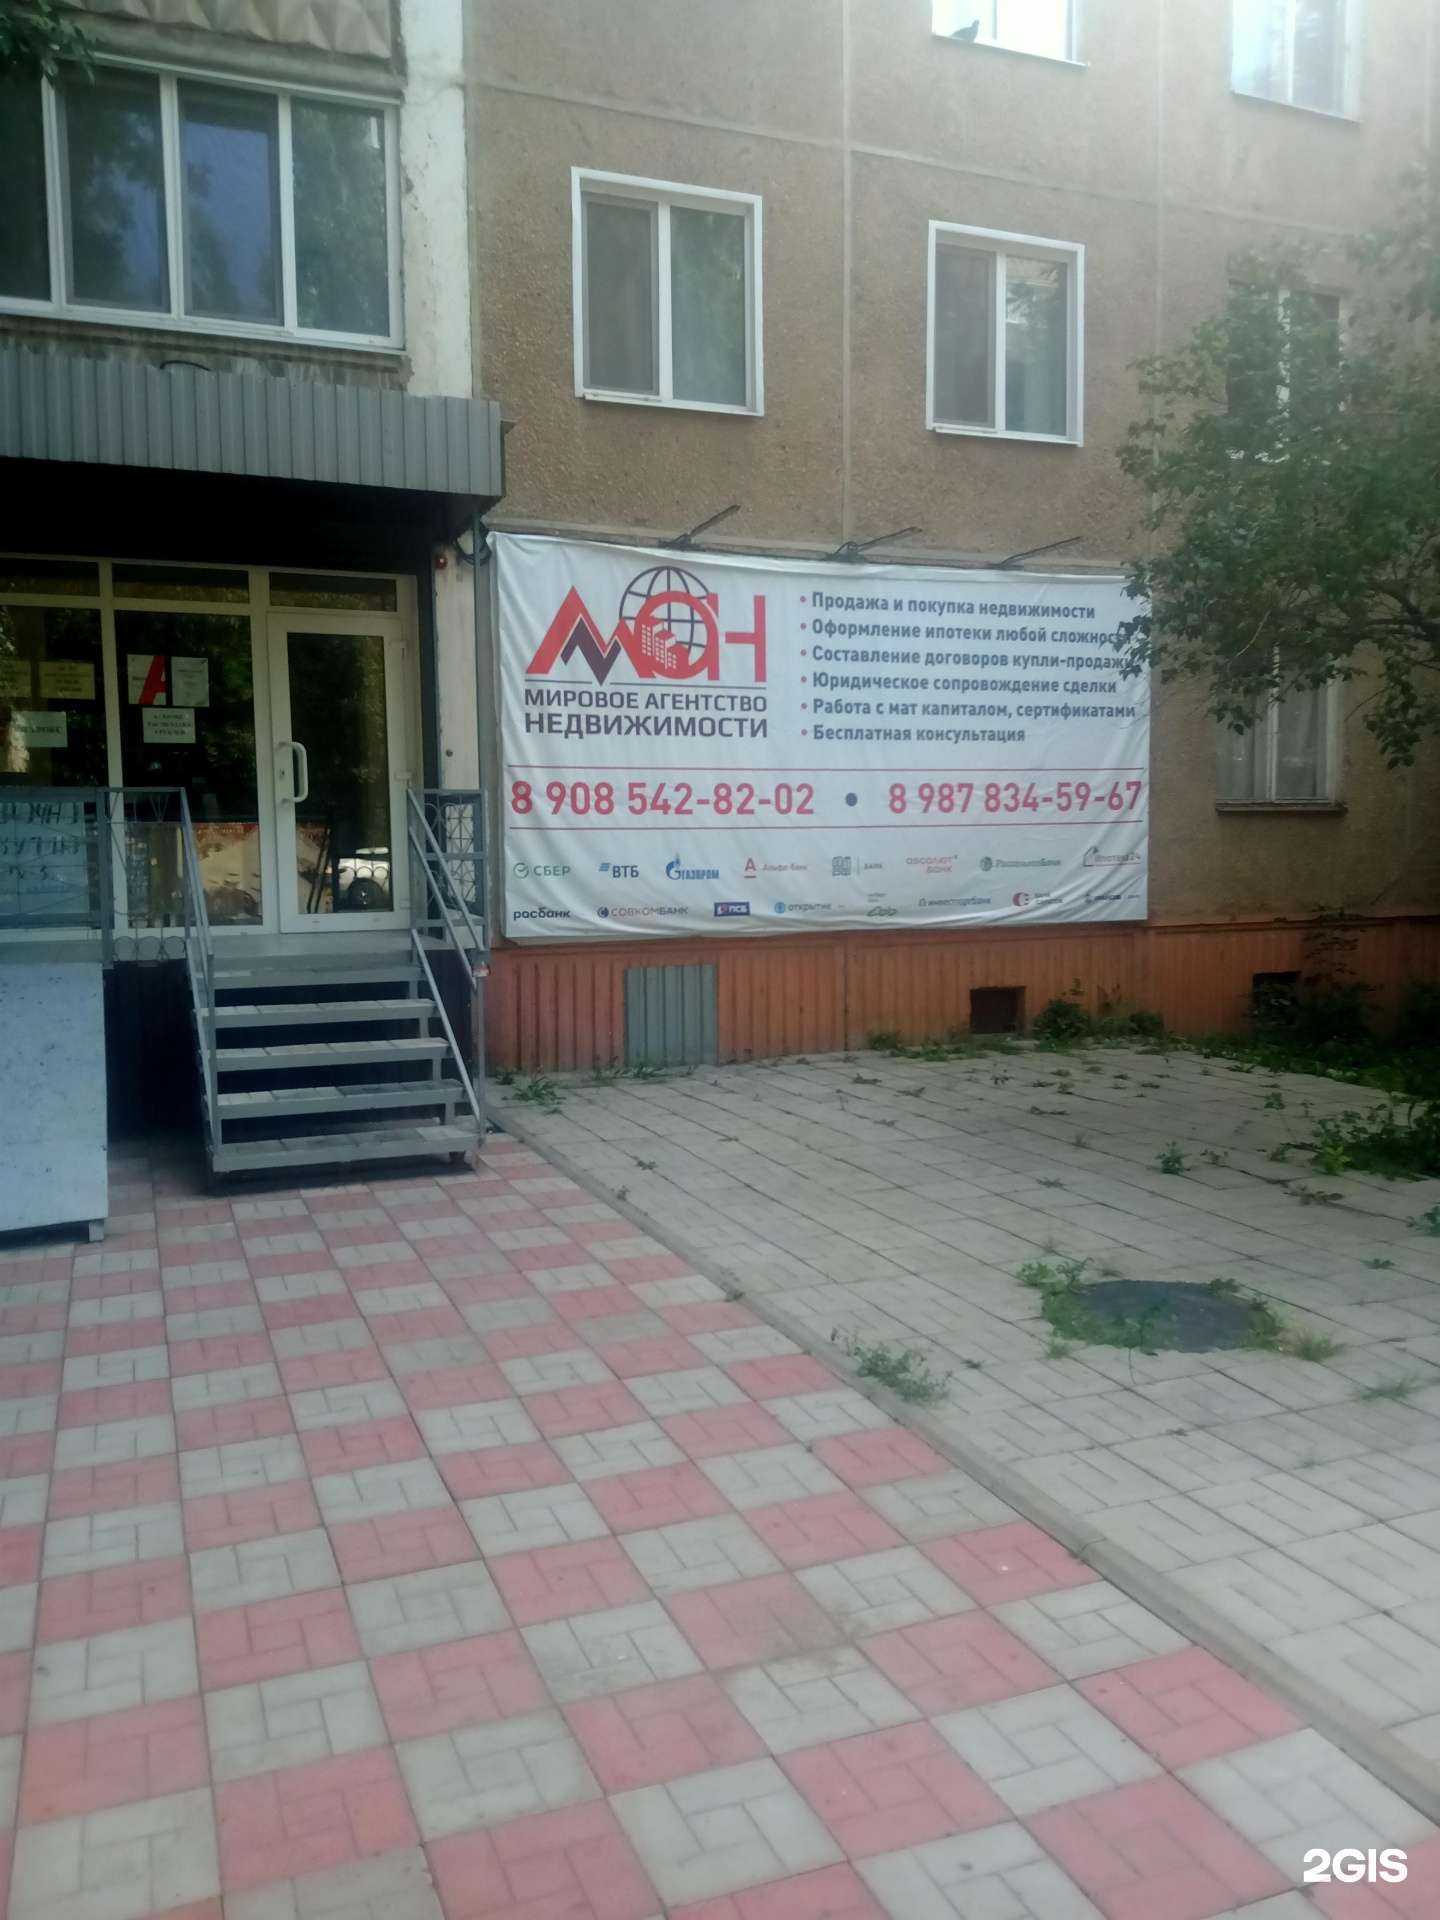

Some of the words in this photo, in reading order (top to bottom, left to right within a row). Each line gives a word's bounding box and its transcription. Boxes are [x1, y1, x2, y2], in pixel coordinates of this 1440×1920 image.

[811, 591, 889, 612] Продажа
[893, 597, 903, 611] и
[907, 599, 975, 618] покупка
[978, 602, 1096, 619] недвижимости
[811, 618, 921, 639] Оформление
[925, 627, 992, 641] ипотеки
[995, 626, 1047, 643] любой
[812, 645, 921, 665] Составление
[924, 652, 1009, 669] договоров
[812, 672, 929, 692] Юридическое
[932, 677, 1060, 695] сопровождение
[1063, 680, 1117, 694] сделки
[524, 689, 639, 710] МИРОВОЕ
[644, 693, 768, 713] АГЕНТСТВО
[812, 698, 871, 716] Работа
[875, 703, 885, 716] с
[888, 702, 918, 716] мат
[922, 703, 1013, 719] капиталом,
[1016, 703, 1136, 719] сертификатами
[524, 713, 769, 739] НЕДВИЖИМОСТИ
[813, 724, 912, 742] Бесплатная
[915, 728, 1026, 744] консультация
[511, 780, 533, 815] 8
[546, 781, 615, 815] 908
[628, 782, 815, 815] 542-82-02
[888, 782, 907, 814] 8
[917, 782, 974, 814] 987
[983, 780, 1143, 813] 834-59-67
[533, 864, 571, 877] СБЕР
[611, 864, 639, 878] ВТБ
[512, 907, 571, 921] росбанк
[610, 906, 689, 917] СОВКОМБАНК
